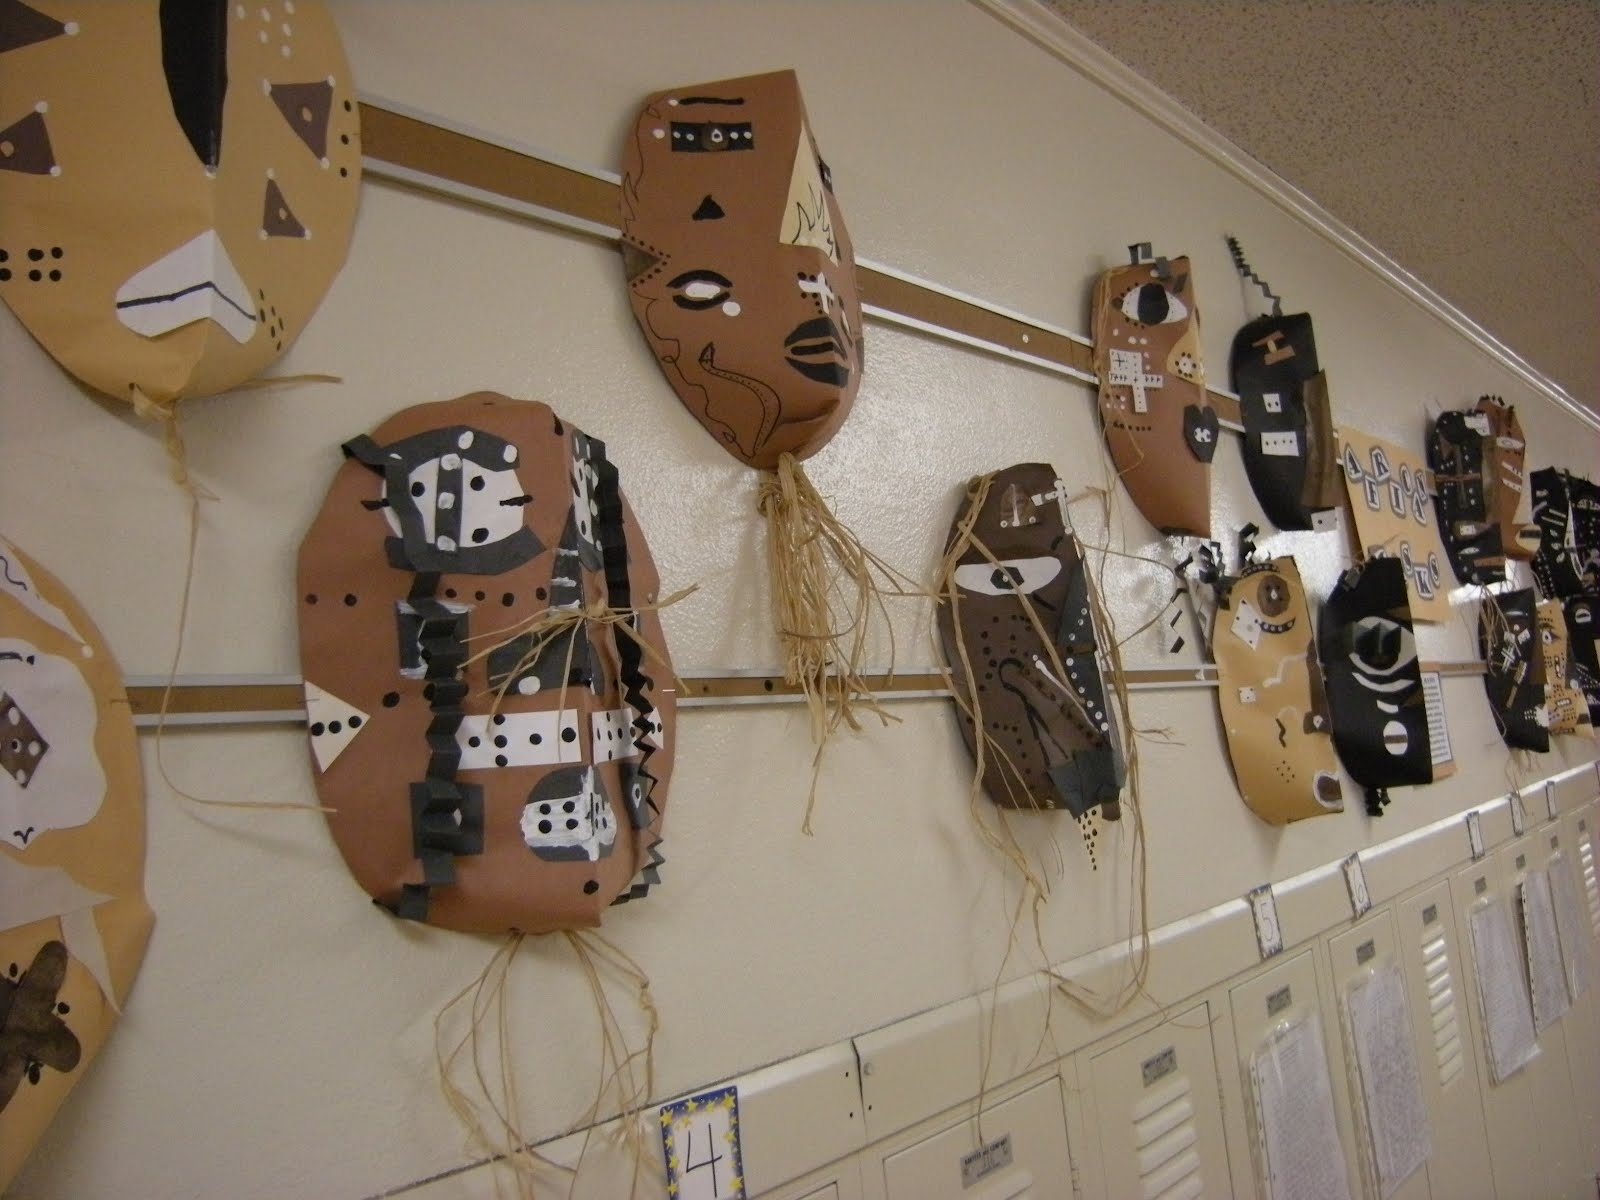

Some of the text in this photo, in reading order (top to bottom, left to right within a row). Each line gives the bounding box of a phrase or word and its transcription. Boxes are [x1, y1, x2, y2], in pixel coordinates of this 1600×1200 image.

[1345, 446, 1428, 524] AFRICAN
[1353, 869, 1364, 903] 6
[1260, 902, 1274, 941] 5
[686, 1122, 723, 1198] 4
